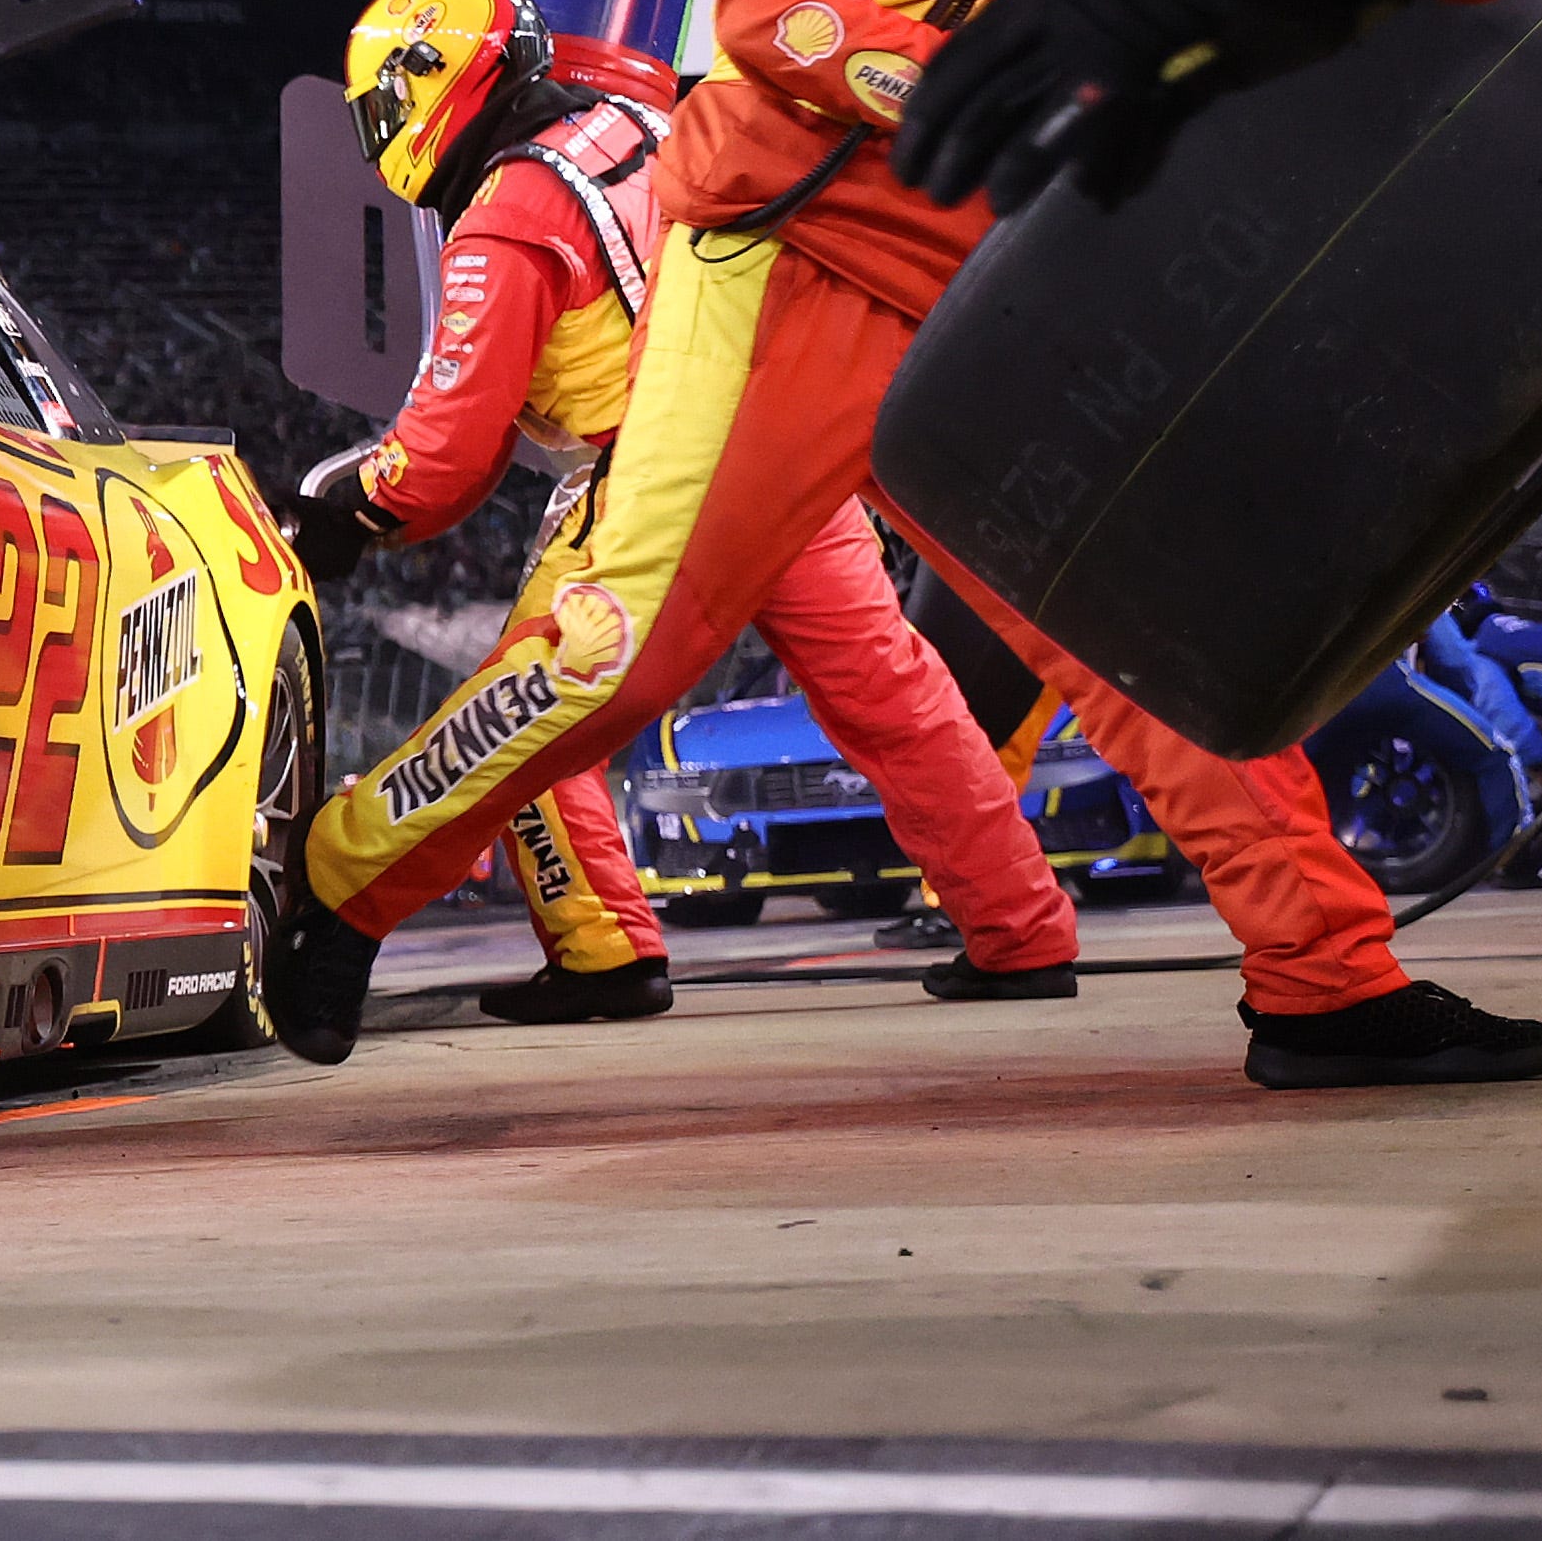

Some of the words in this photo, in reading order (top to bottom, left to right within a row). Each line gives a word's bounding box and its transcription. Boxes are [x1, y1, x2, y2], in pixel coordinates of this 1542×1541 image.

[113, 572, 199, 733] PENNZOIL
[377, 663, 557, 824] PENNZOIL
[167, 975, 198, 997] FORD
[199, 970, 237, 994] RACING
